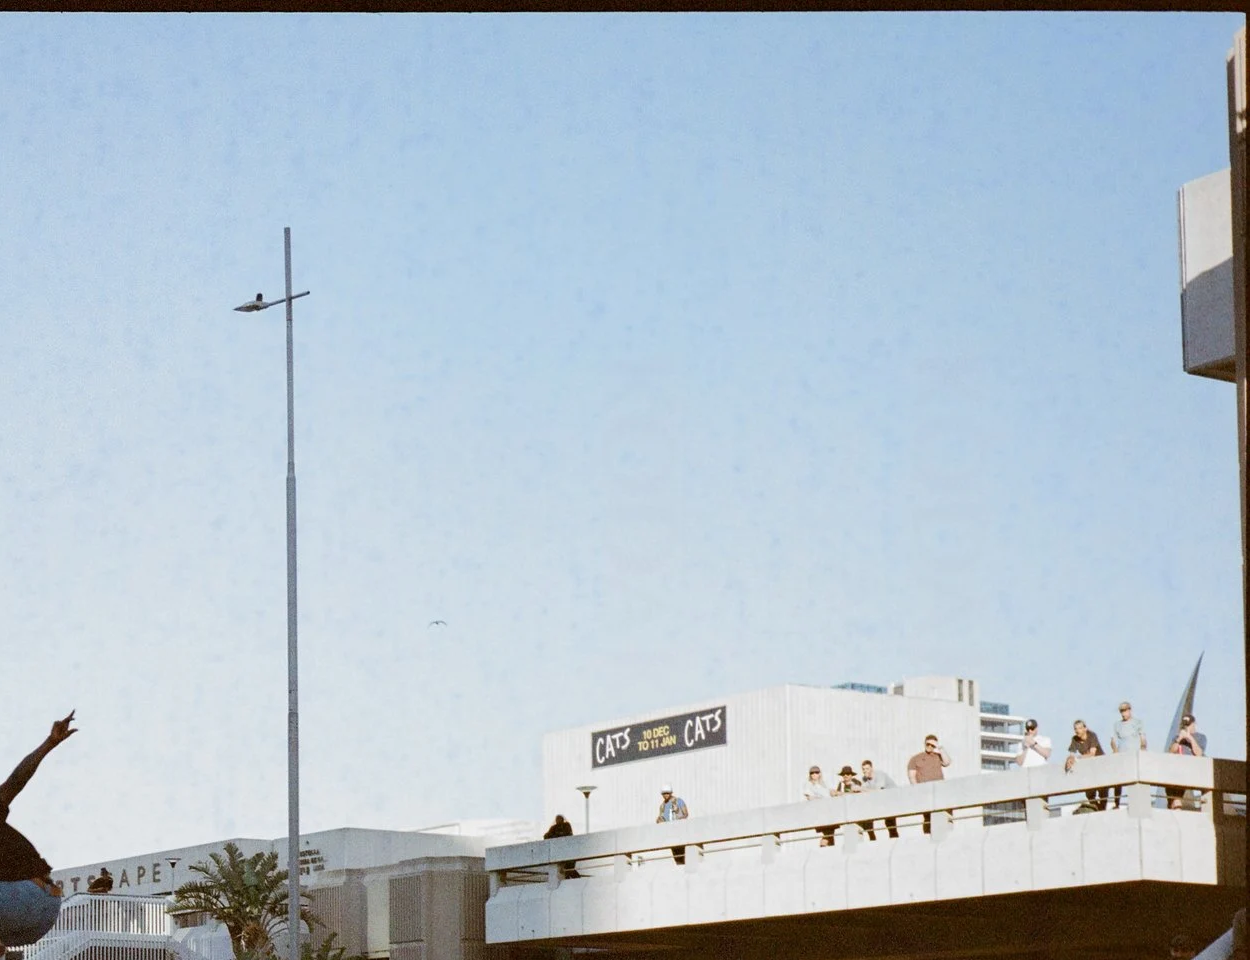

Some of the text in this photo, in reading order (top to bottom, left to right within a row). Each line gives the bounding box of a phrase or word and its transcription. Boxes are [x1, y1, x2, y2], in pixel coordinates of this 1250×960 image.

[642, 725, 670, 740] 10 DEC
[684, 709, 722, 747] CATS
[596, 728, 631, 764] CATS
[637, 734, 677, 751] TO 11 JAN
